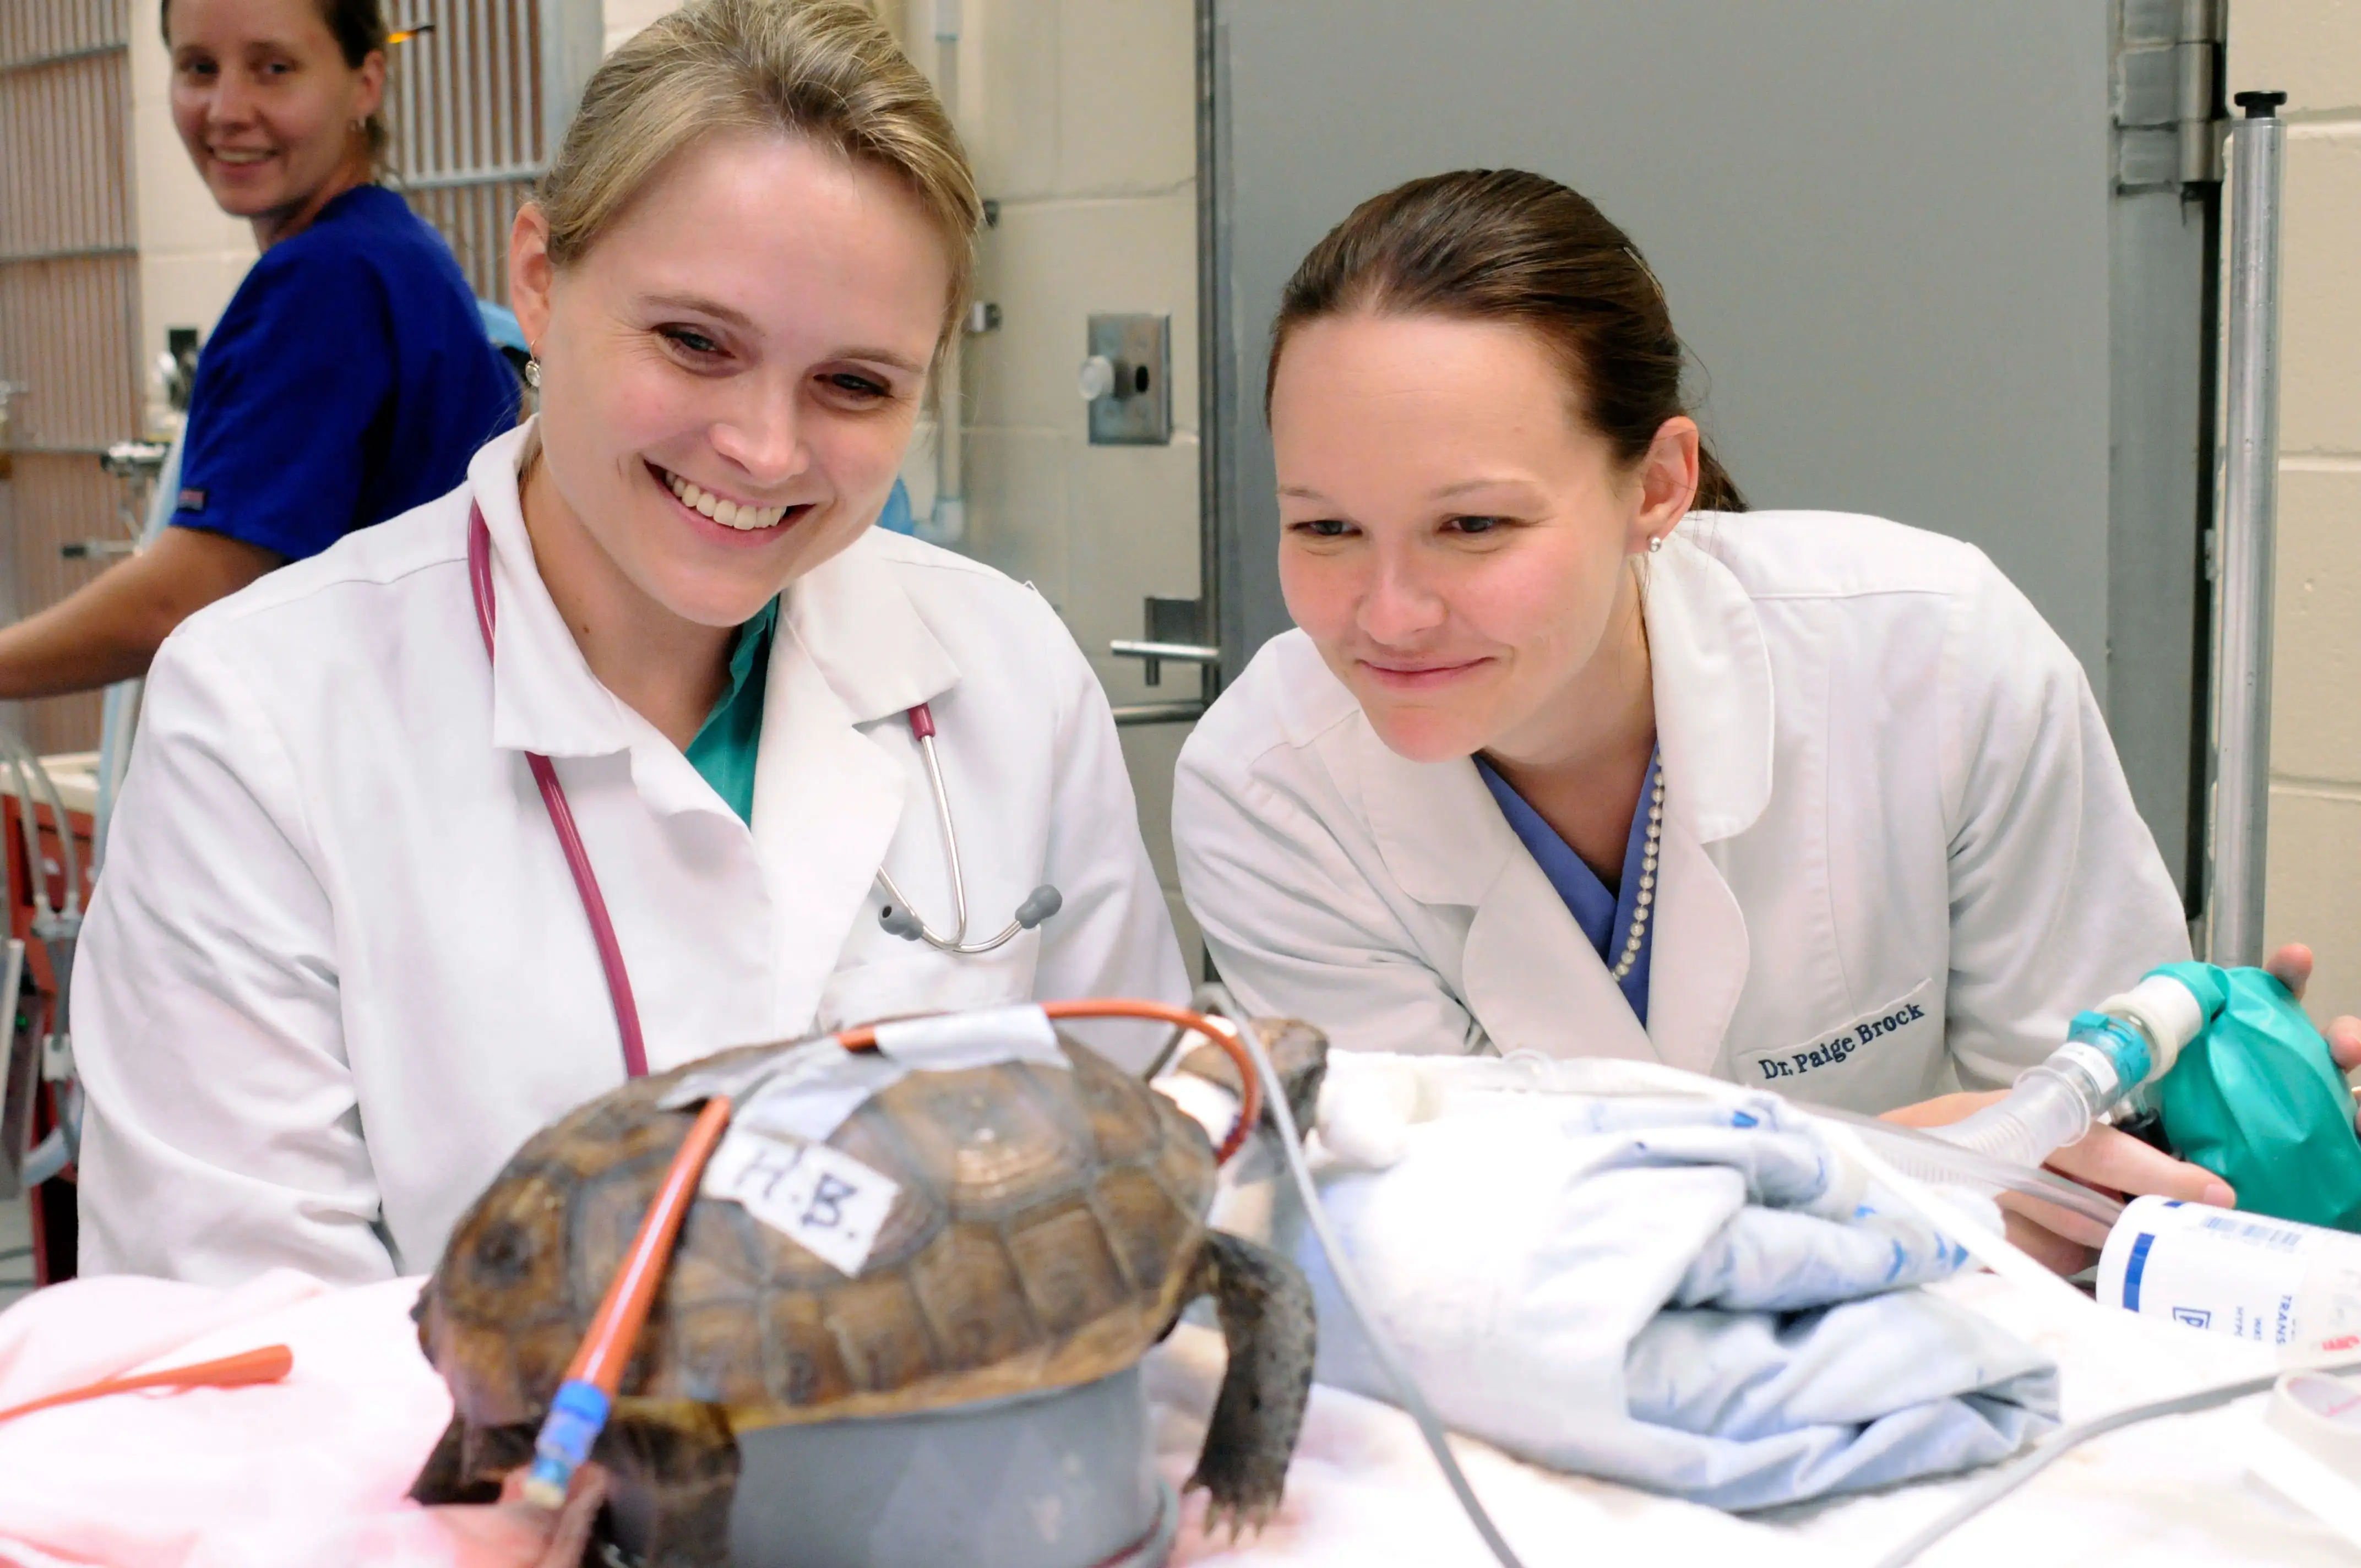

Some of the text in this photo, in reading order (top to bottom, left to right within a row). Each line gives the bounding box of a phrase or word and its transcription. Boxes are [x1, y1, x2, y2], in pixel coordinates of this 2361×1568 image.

[1758, 1003, 1925, 1080] Dr. Paige Brock
